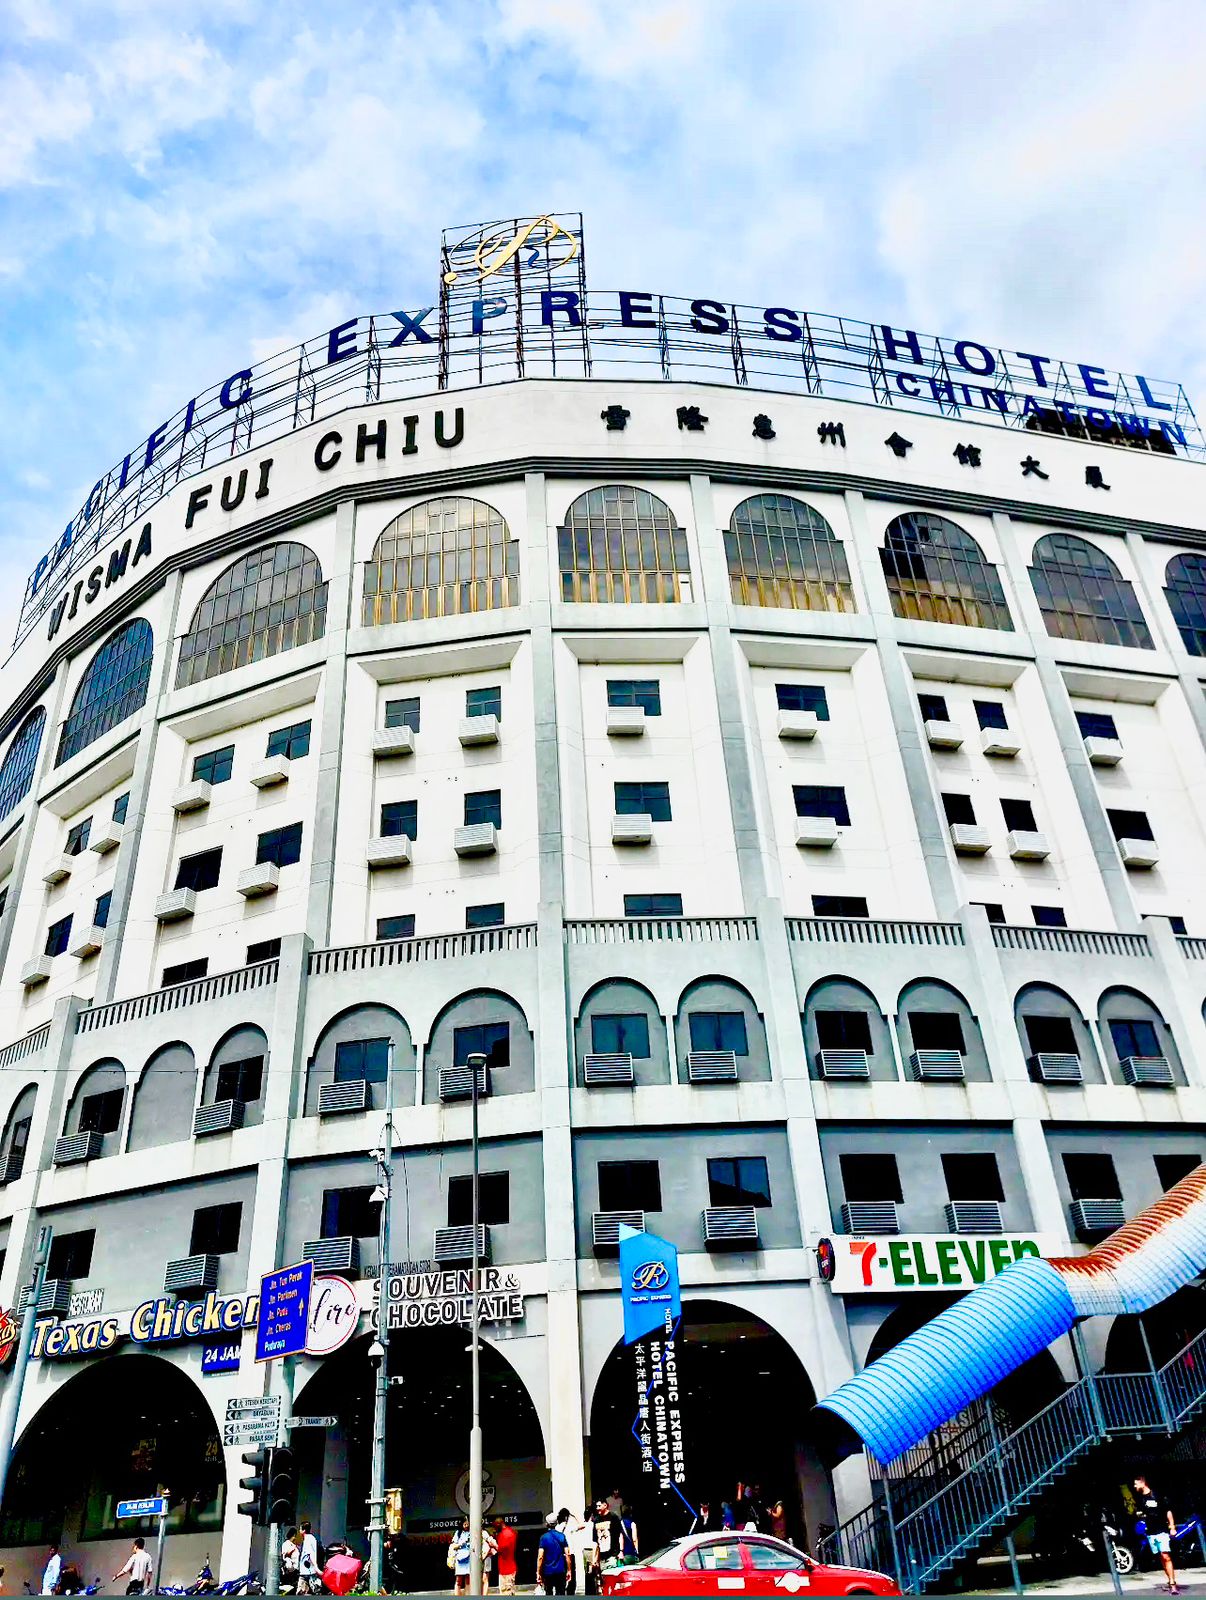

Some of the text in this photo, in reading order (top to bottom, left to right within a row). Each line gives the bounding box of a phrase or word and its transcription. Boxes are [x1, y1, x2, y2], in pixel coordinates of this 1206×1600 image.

[31, 290, 1172, 596] PACIFIC EXPRESS HOTEL
[895, 373, 1188, 446] CHINATOWN
[48, 407, 464, 642] WISMA FUI CHIU
[370, 1294, 524, 1330] CHOCOLATE
[373, 1268, 500, 1301] SOUVENIR
[30, 1318, 118, 1360] Texas
[129, 1290, 261, 1342] Chicken
[204, 1348, 218, 1364] 24
[650, 1341, 671, 1489] HOTEL CHINATOWN
[664, 1340, 686, 1483] PACIFIC EXPRESS
[429, 1520, 462, 1529] SNOOKE
